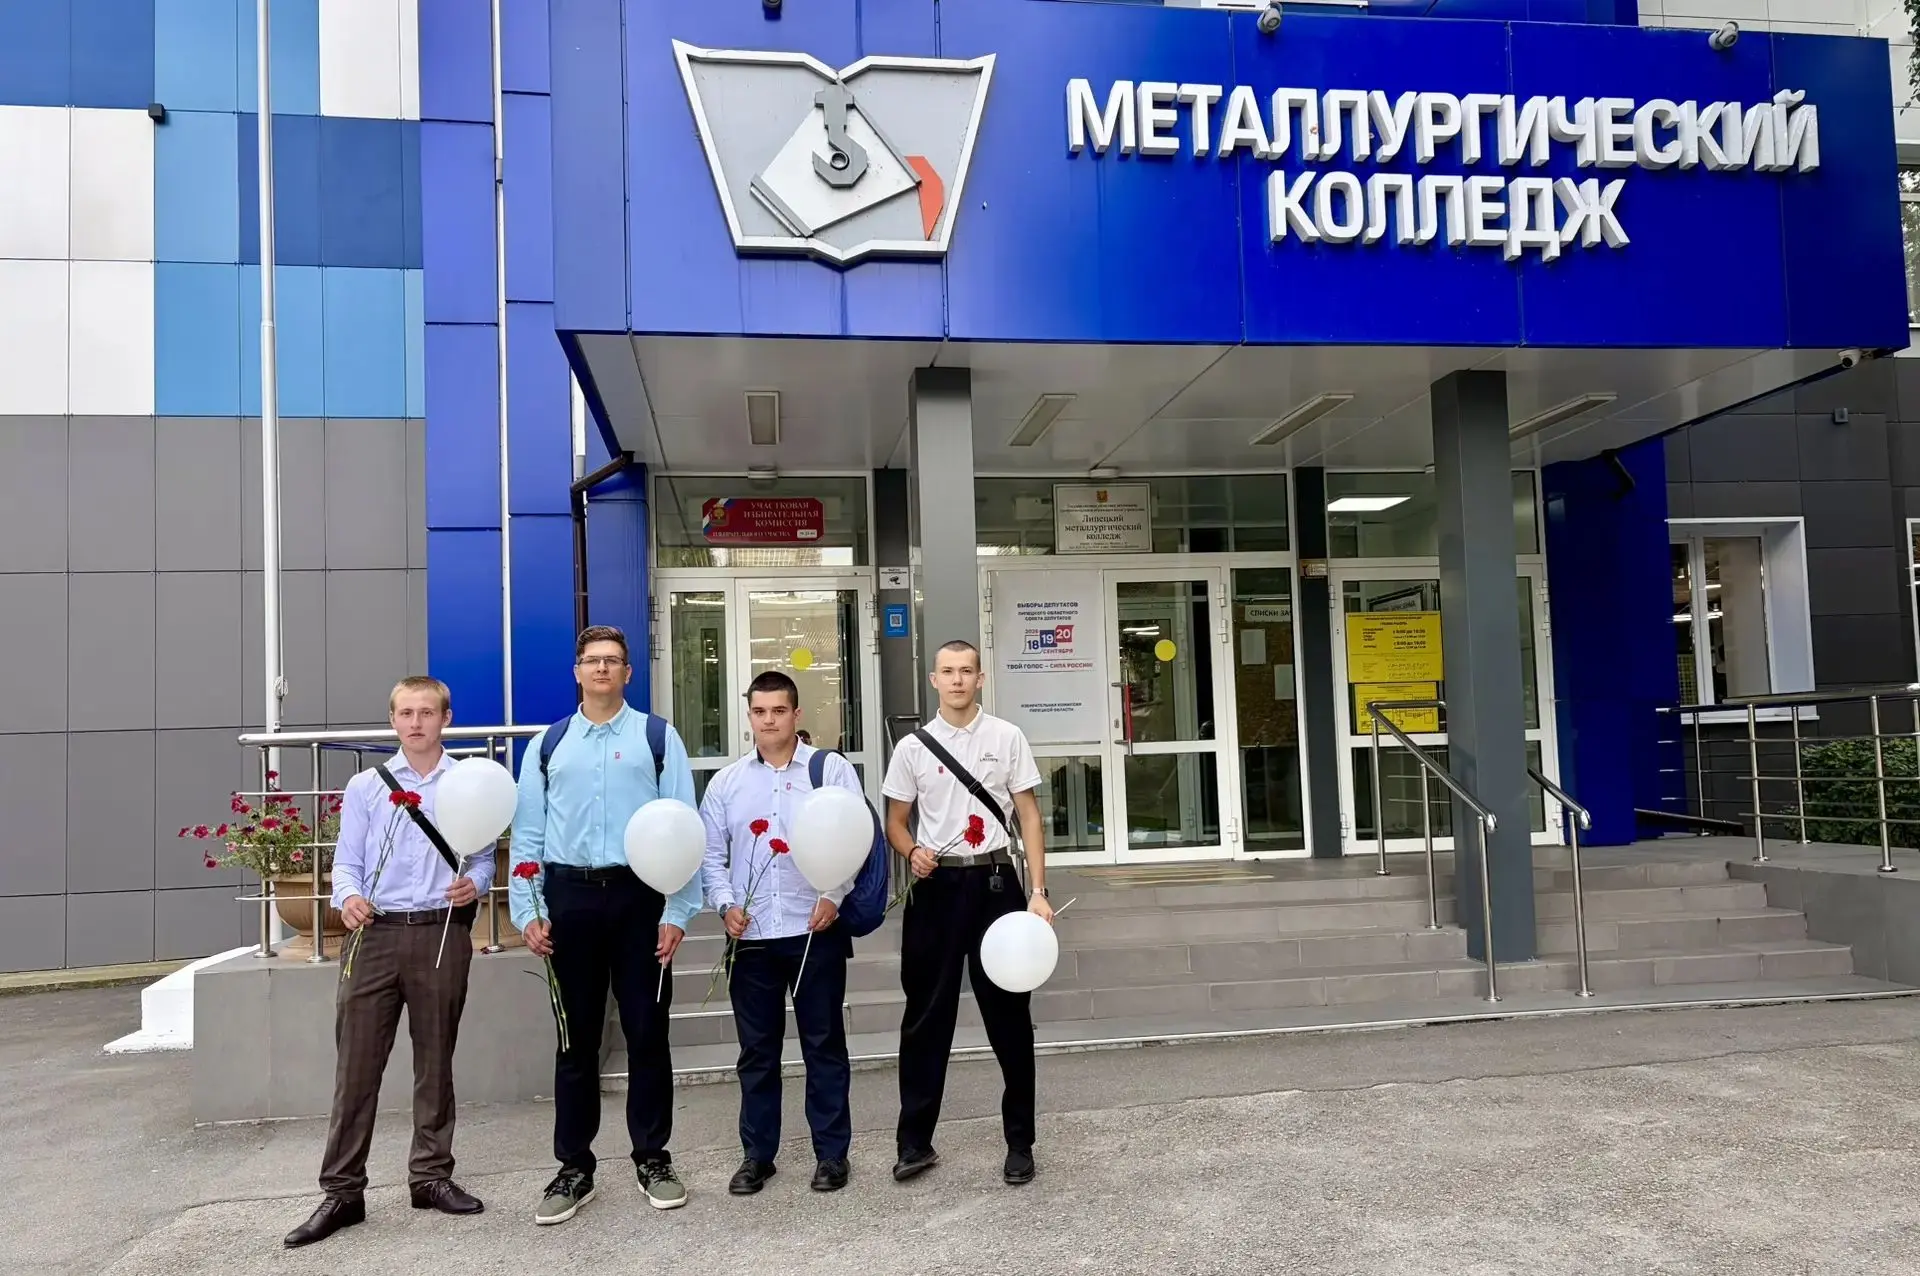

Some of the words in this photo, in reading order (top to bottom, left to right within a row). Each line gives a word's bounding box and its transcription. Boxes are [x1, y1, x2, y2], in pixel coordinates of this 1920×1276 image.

[1065, 78, 1820, 173] МЕТАЛЛУРГИЧЕСКИЙ
[1267, 169, 1631, 262] КОЛЛЕДЖ
[750, 501, 809, 509] УЧАСТКОВАЯ
[743, 510, 819, 518] ИЗБИРАТЕЛЬНАЯ
[1082, 514, 1124, 523] Липецкий
[755, 519, 808, 527] КОМИССИЯ
[1064, 522, 1142, 533] металлургический
[1041, 634, 1054, 644] 19
[1056, 629, 1071, 639] 20
[1027, 640, 1040, 650] 18
